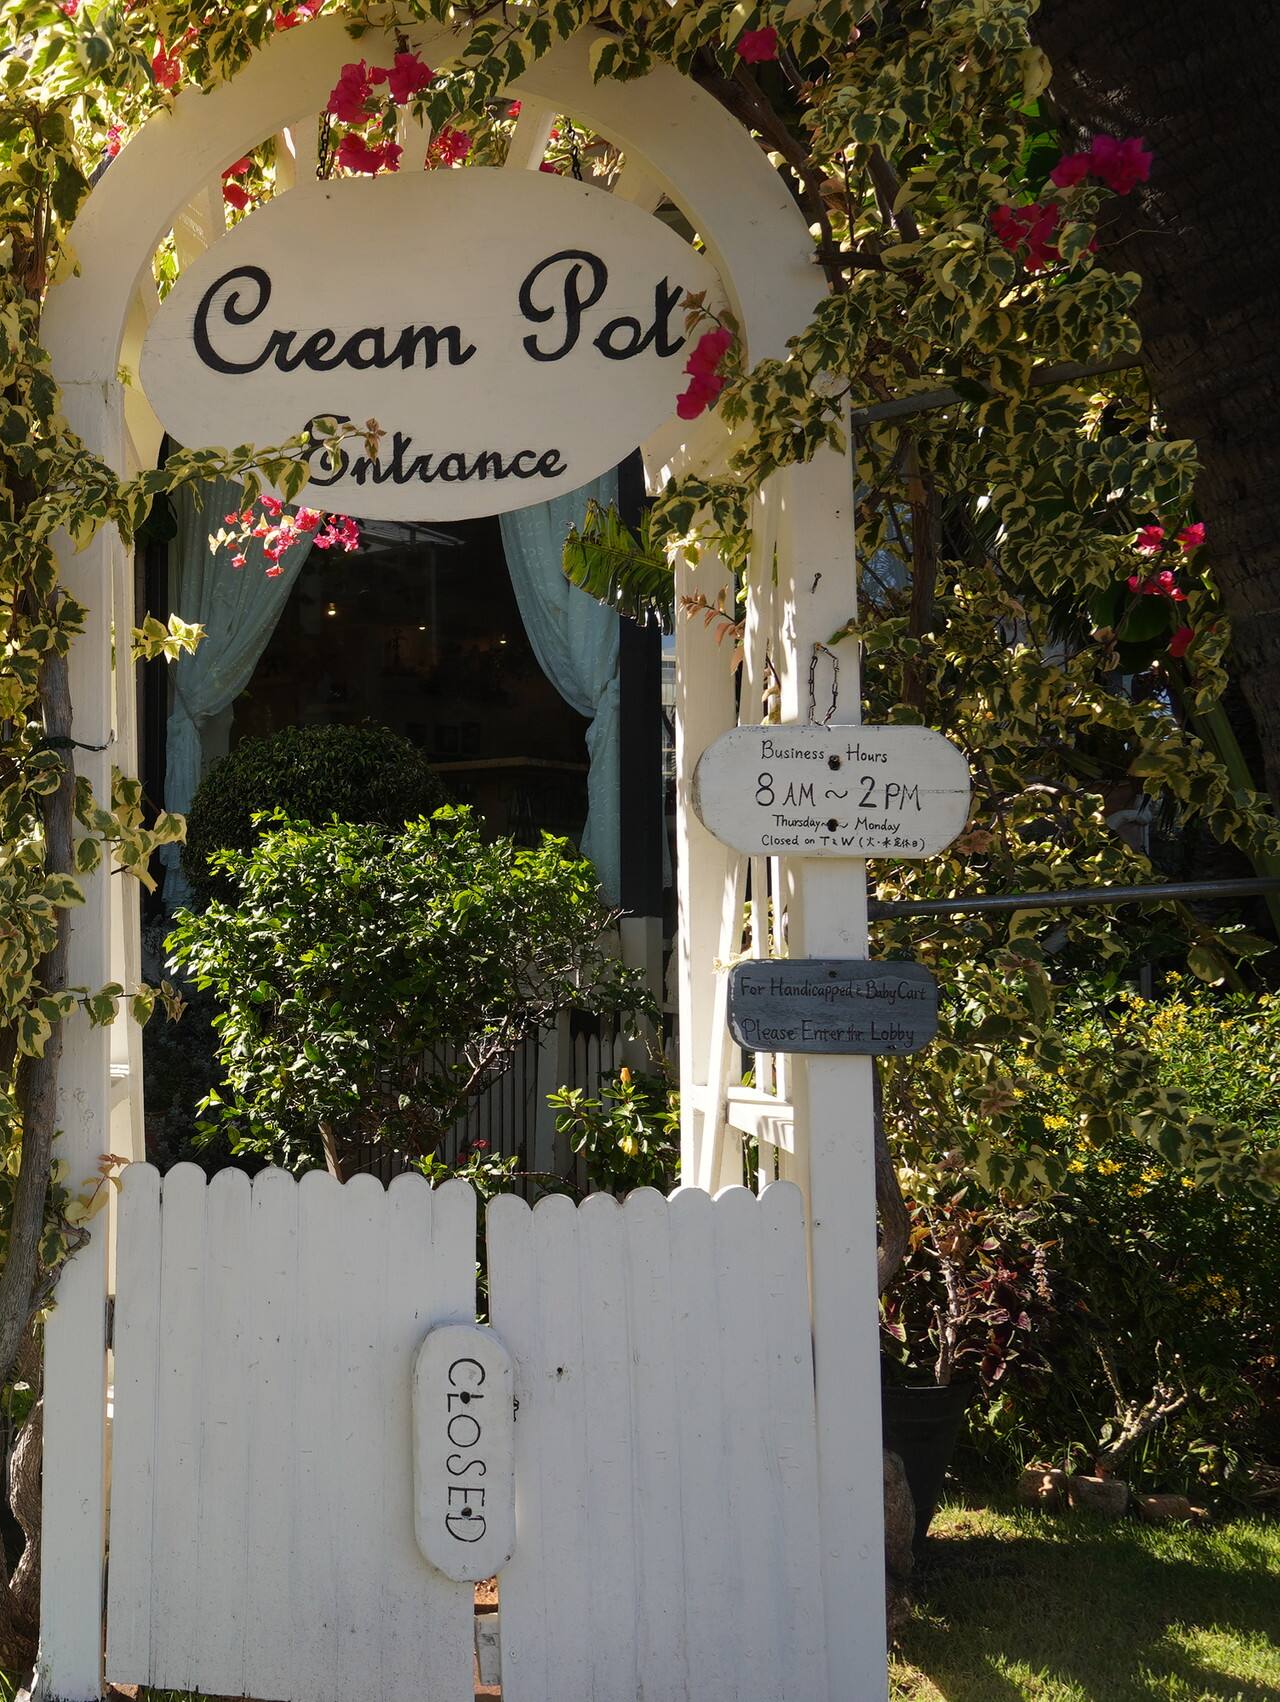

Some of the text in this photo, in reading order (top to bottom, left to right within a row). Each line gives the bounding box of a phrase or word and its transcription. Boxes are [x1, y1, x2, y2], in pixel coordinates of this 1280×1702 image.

[193, 249, 687, 374] Cream Pot
[300, 413, 567, 486] Entrance
[761, 739, 888, 763] Business Hours
[772, 814, 821, 833] Thursday
[854, 817, 901, 834] Monday
[761, 834, 799, 846] Closed
[819, 836, 830, 846] T
[841, 836, 855, 847] W
[740, 977, 765, 996] For
[770, 977, 852, 1002] Handicapped
[741, 1018, 796, 1042] Please
[801, 1019, 848, 1042] Enter
[870, 1021, 914, 1048] Lobby
[445, 1358, 487, 1542] CLOSED
